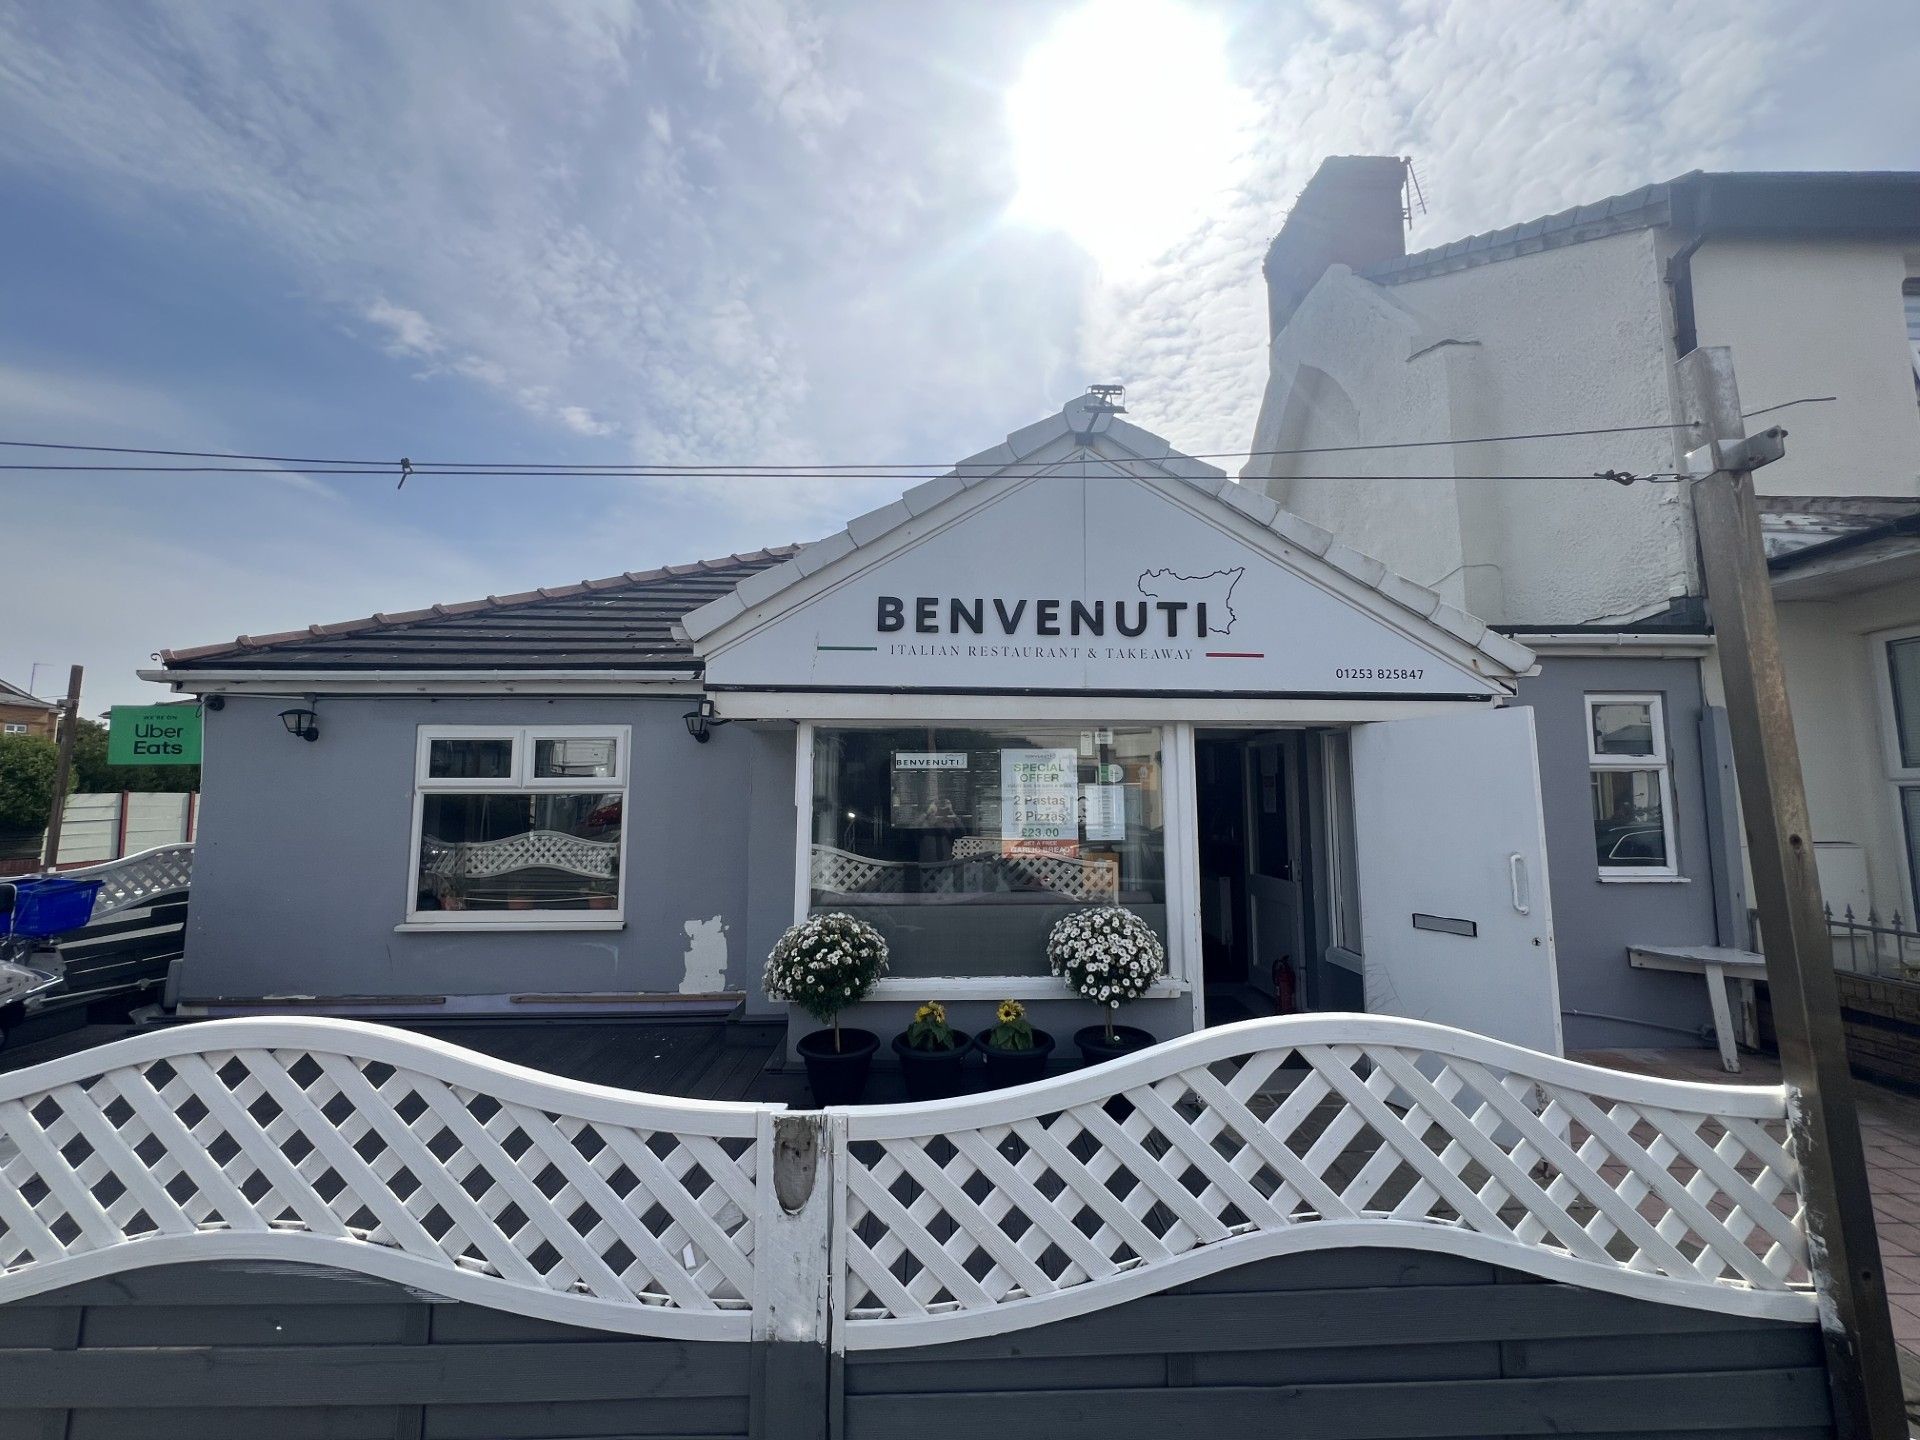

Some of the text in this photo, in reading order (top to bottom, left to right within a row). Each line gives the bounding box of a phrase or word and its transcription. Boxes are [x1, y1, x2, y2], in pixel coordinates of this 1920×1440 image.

[877, 596, 1208, 638] BENVENUTI
[890, 644, 1194, 661] ITALIAN RESTAURANT & TAKEAWAY
[1336, 668, 1424, 680] 01253 825847
[135, 723, 184, 738] Uber
[133, 741, 183, 755] Eats
[1013, 763, 1065, 772] SPECIAL
[1019, 773, 1060, 783] OFFER
[1013, 795, 1066, 806] 2 Pastas
[1014, 811, 1066, 823] 2 Pizzas
[1021, 828, 1060, 838] £23.00
